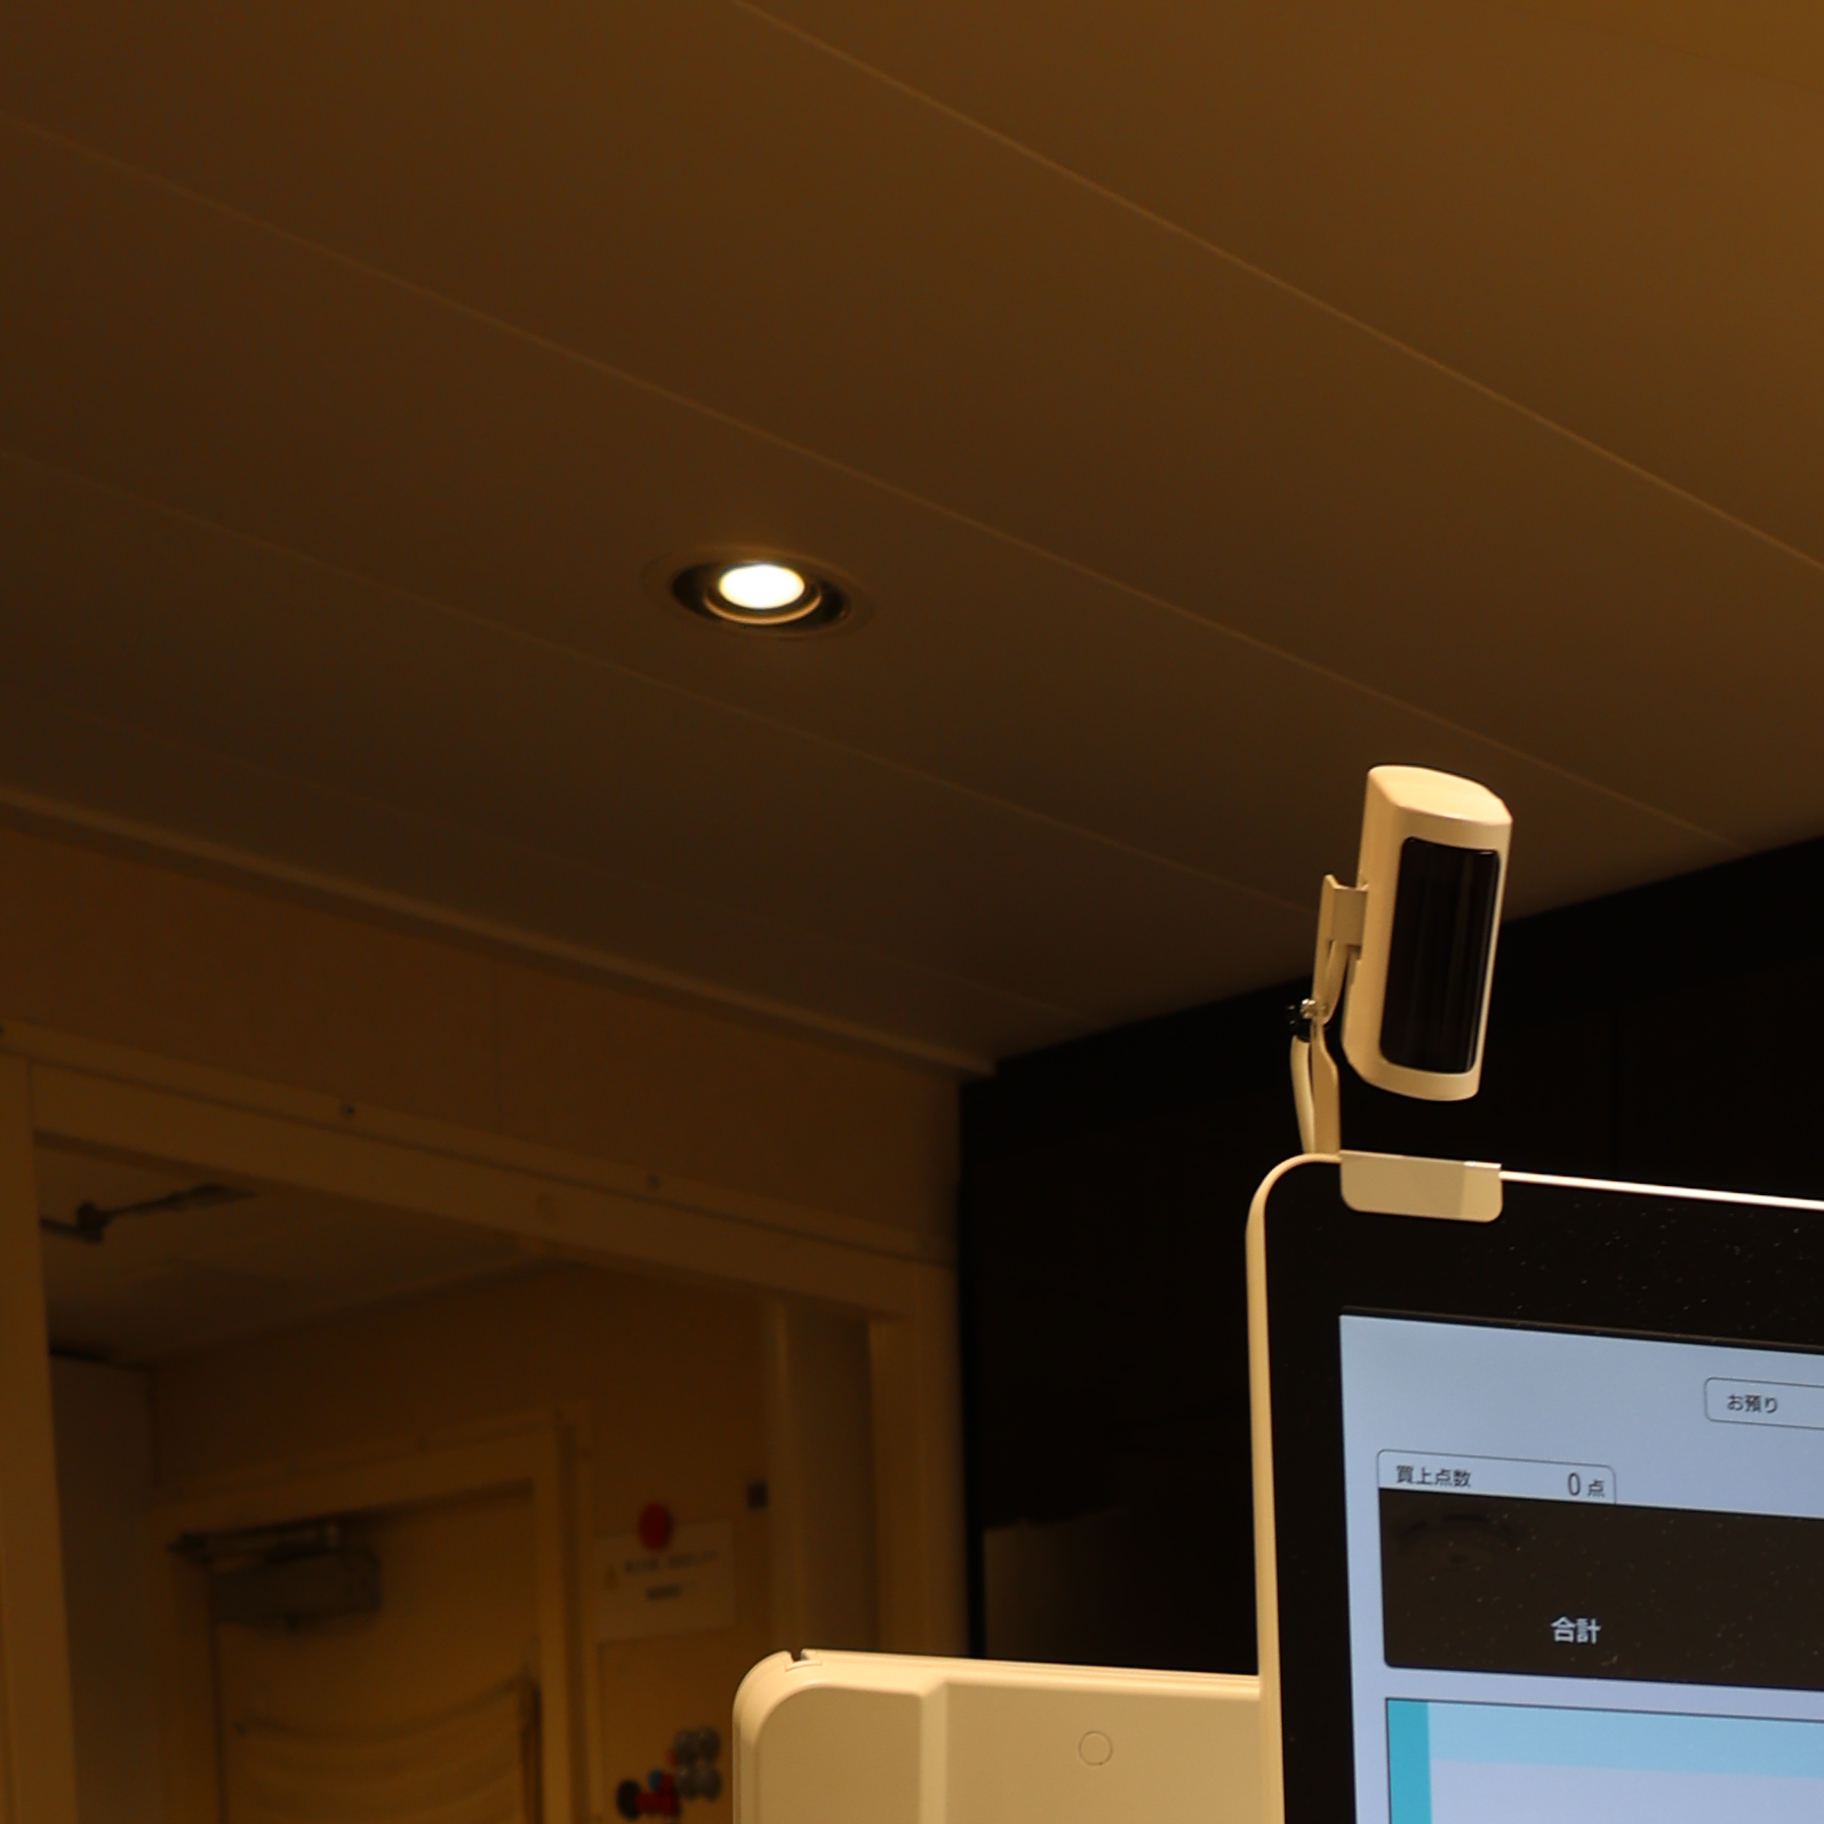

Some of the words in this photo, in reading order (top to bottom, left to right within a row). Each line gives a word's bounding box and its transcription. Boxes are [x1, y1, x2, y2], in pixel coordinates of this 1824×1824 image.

[1726, 1391, 1779, 1415] お預り
[1396, 1465, 1472, 1488] 買上点数
[1567, 1472, 1581, 1497] 0
[1587, 1479, 1606, 1499] 点
[1551, 1616, 1601, 1644] 合計
